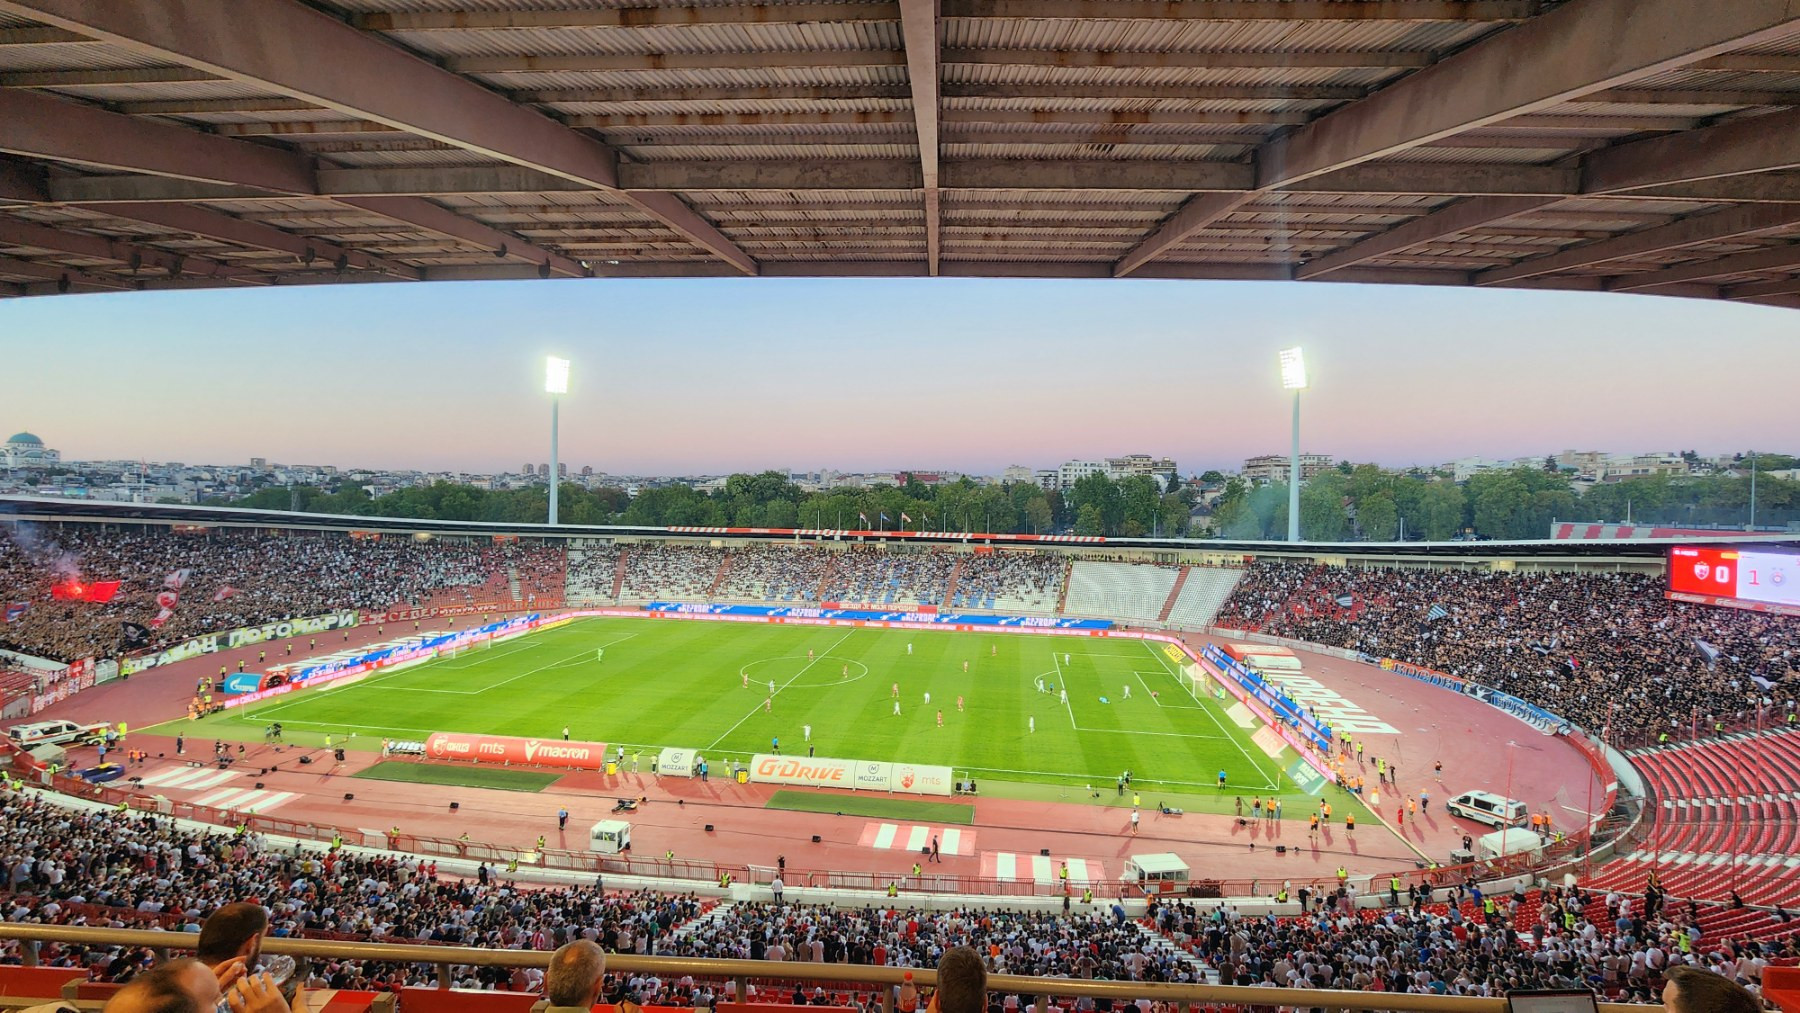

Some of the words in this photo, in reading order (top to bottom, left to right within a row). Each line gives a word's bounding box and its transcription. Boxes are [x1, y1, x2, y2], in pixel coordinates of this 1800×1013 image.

[1715, 566, 1729, 583] 0
[1749, 569, 1760, 585] 1
[479, 742, 505, 755] mts
[538, 745, 589, 760] macron
[921, 776, 942, 786] mts
